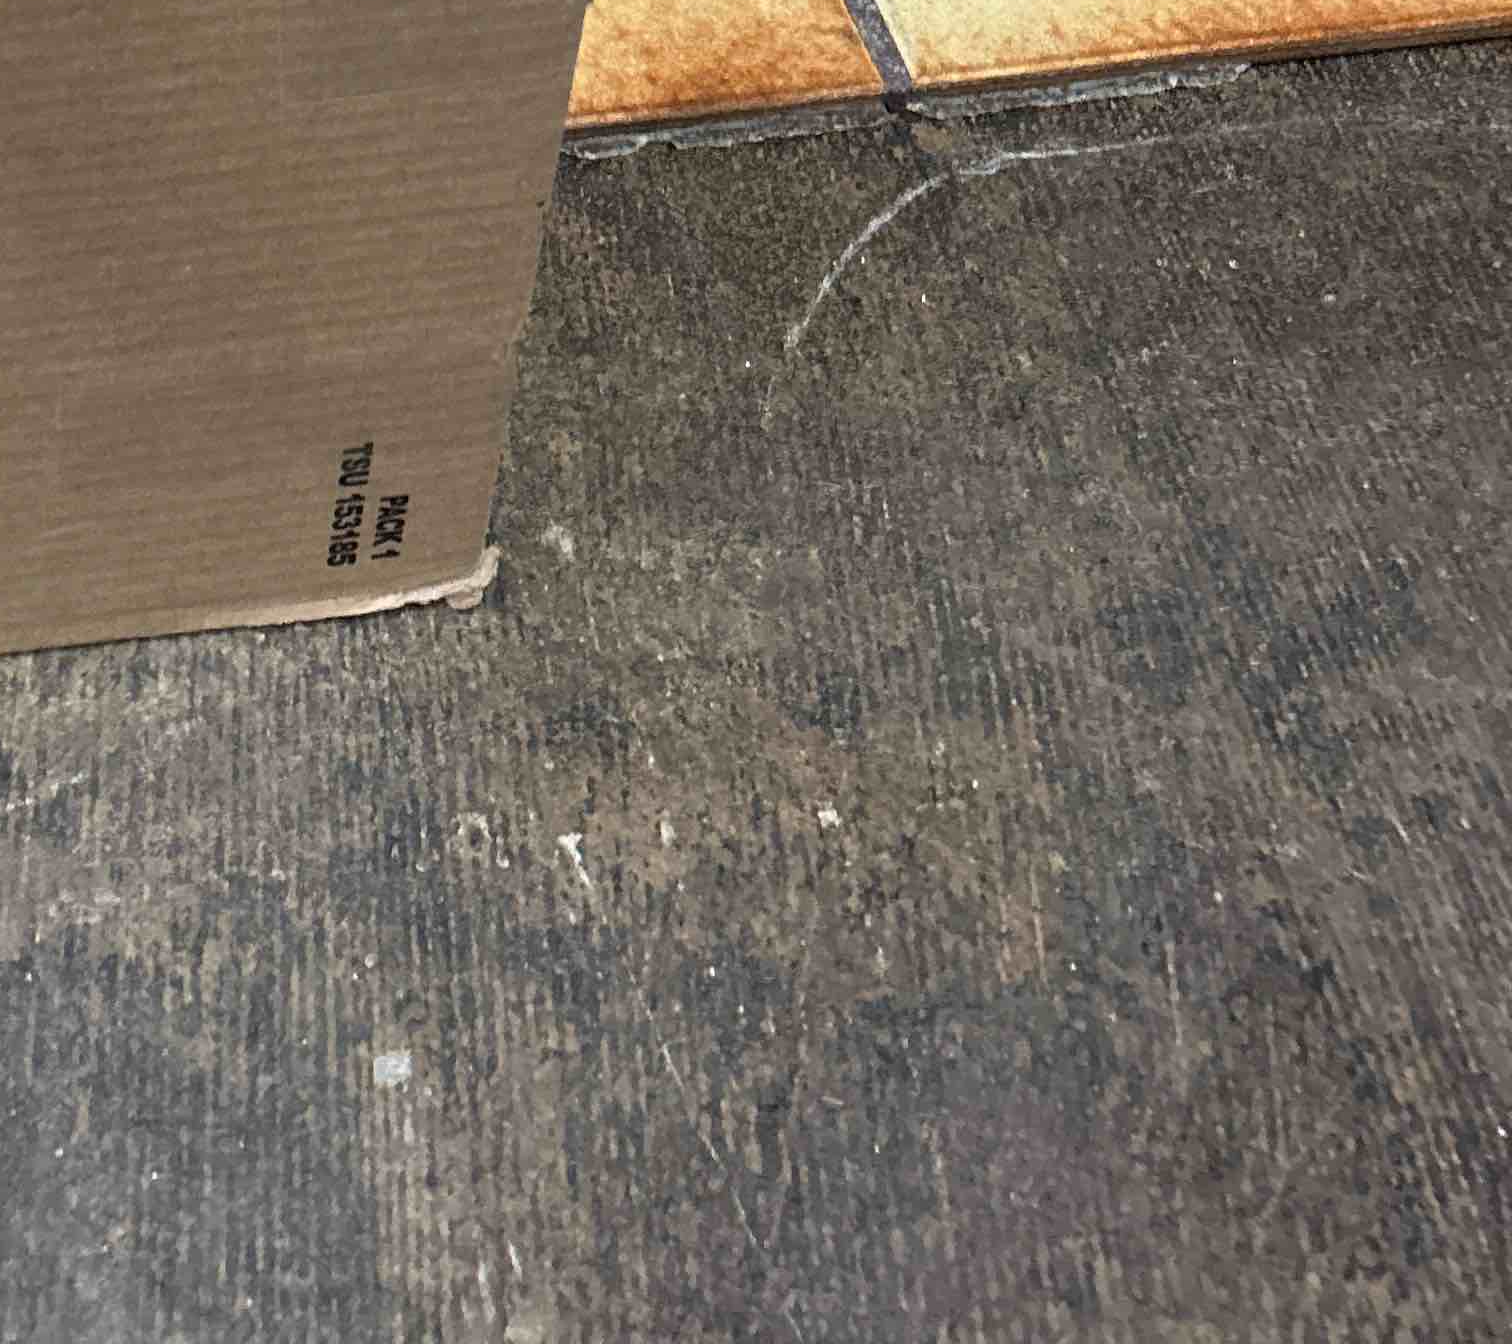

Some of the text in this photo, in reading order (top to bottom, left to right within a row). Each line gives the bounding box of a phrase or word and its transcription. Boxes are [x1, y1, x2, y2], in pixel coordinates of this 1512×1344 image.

[326, 441, 375, 567] TSU 153185
[370, 495, 409, 561] PACK 1
